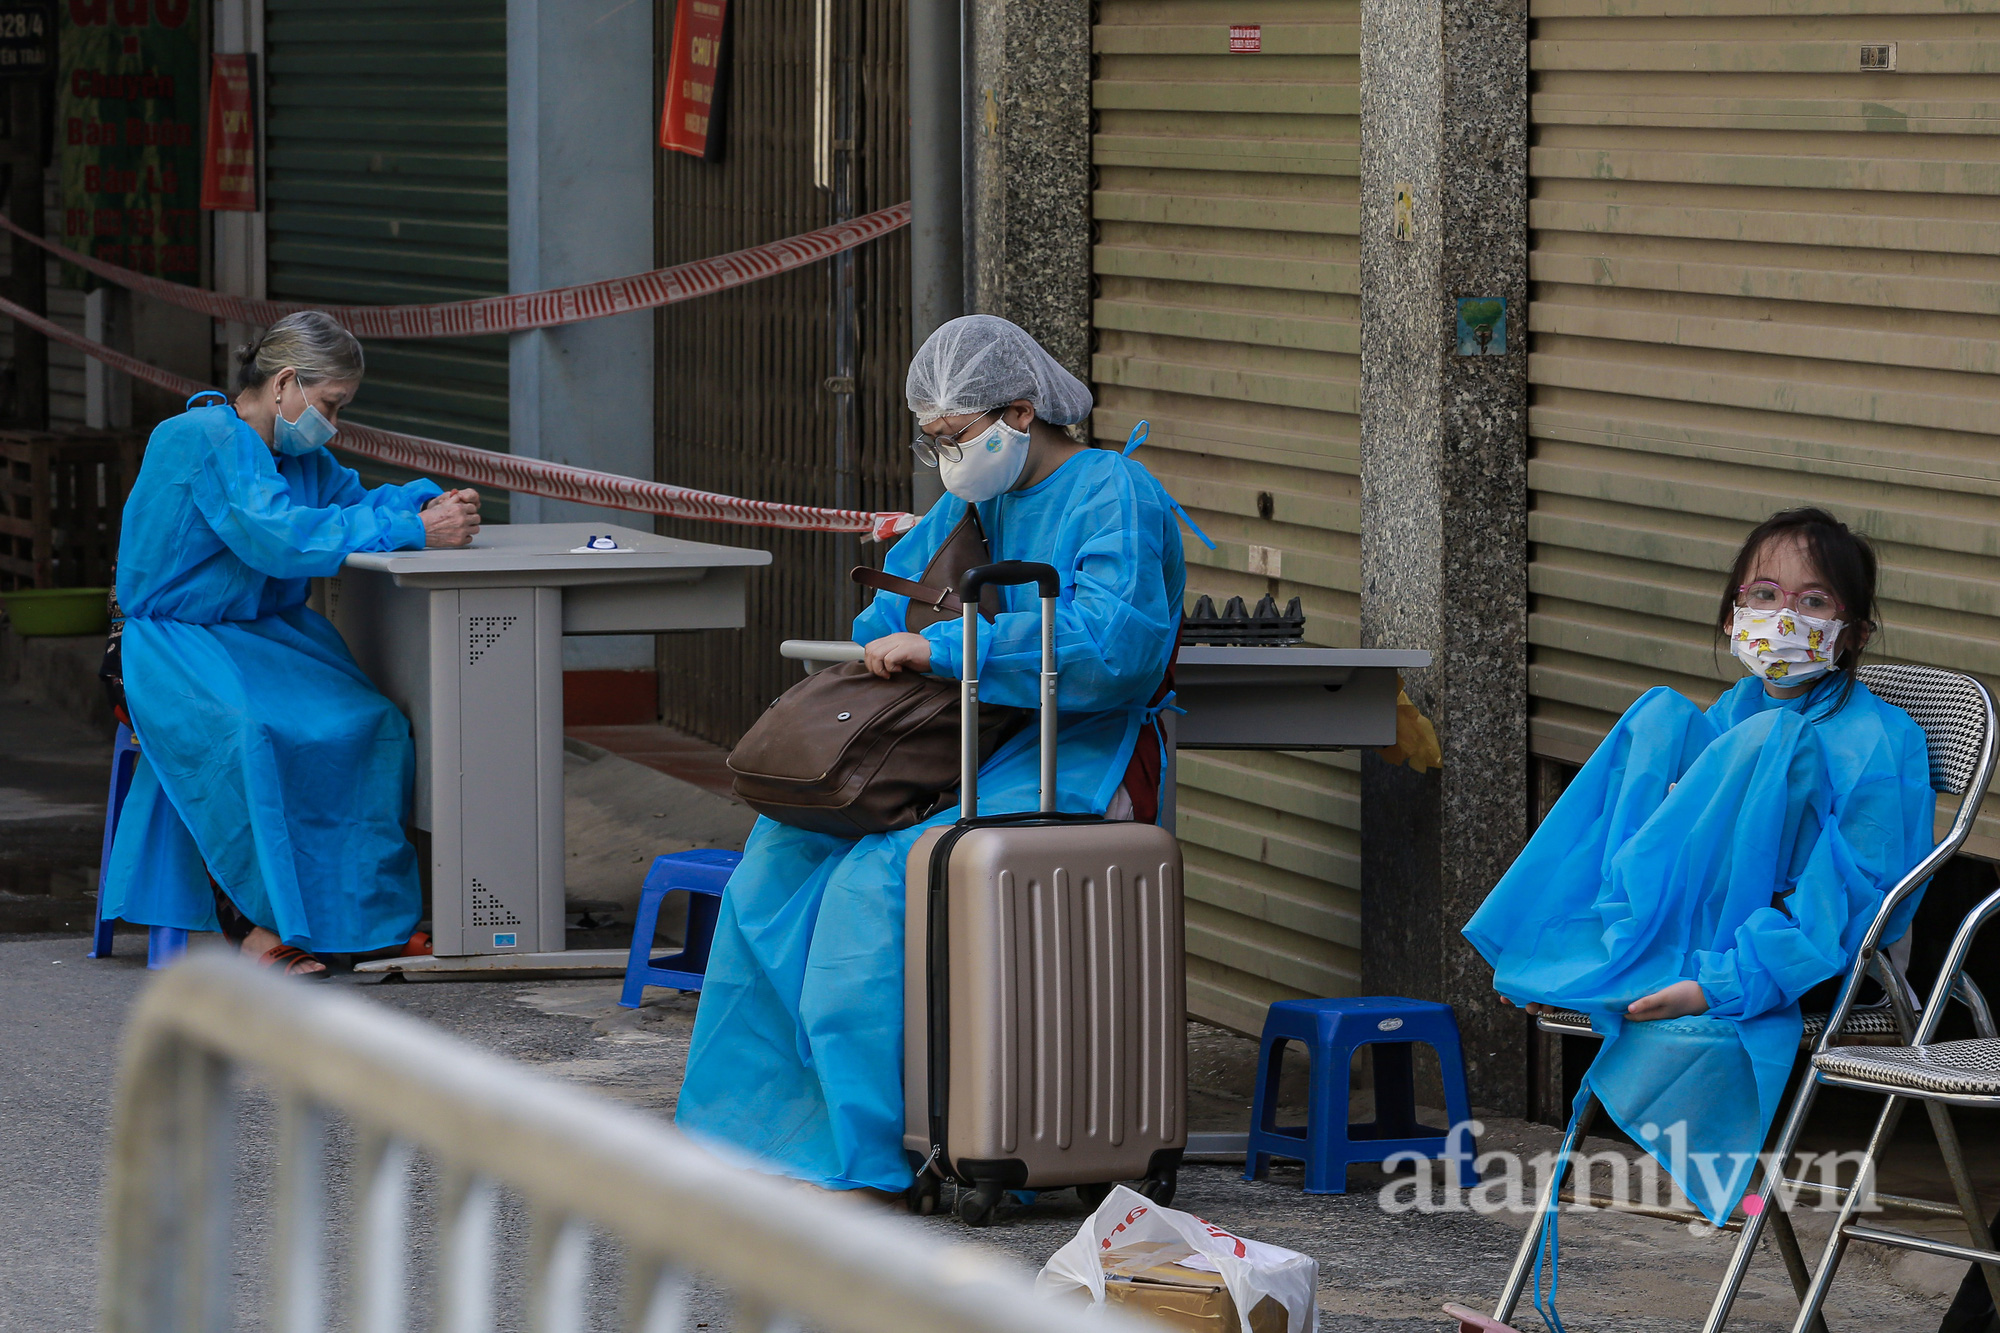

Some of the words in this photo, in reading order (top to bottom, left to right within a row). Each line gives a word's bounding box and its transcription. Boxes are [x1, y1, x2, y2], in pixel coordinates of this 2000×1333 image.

[72, 67, 174, 101] Chuyên
[126, 117, 191, 146] Buôn
[84, 163, 137, 194] Bán
